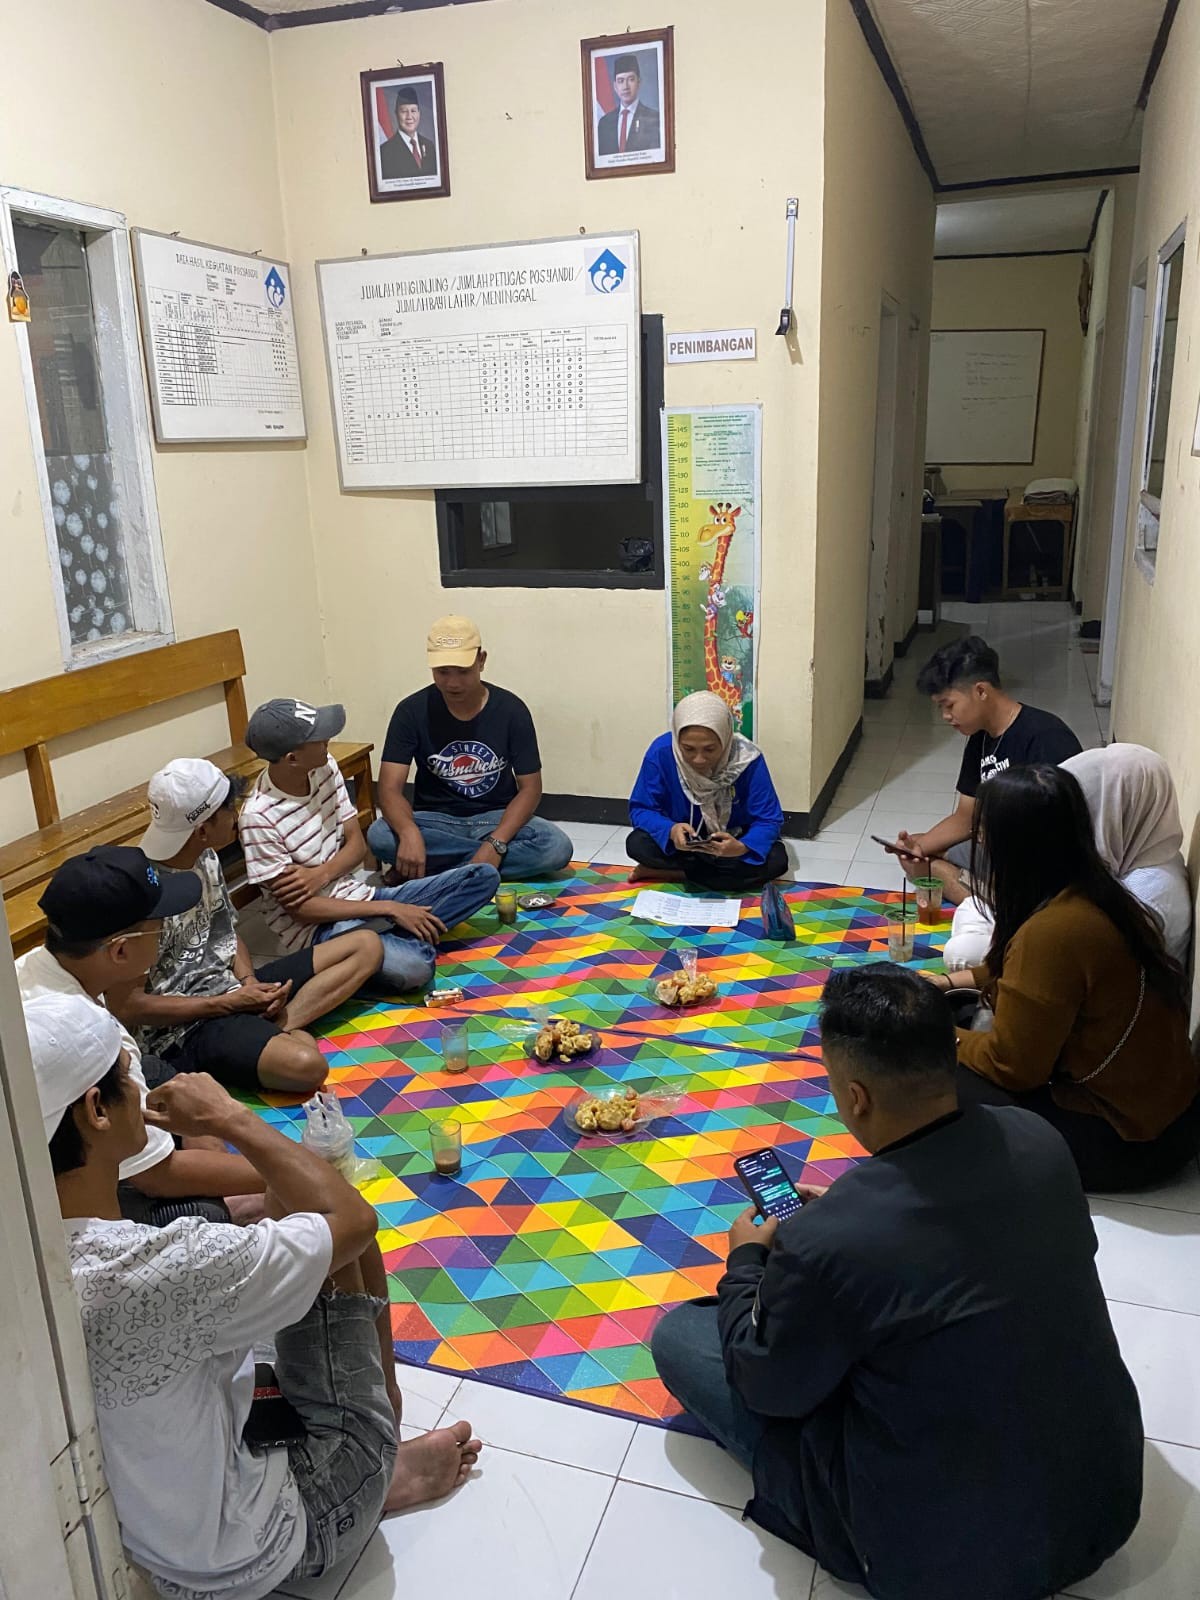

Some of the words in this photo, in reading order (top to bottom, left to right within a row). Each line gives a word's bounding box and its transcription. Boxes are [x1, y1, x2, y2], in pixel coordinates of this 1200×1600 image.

[360, 282, 394, 300] JUMLAH
[490, 270, 527, 287] PETUGAS
[530, 267, 574, 284] POSYANDU
[396, 297, 428, 314] JUMLAH
[670, 336, 753, 355] PENIMBANGAN
[452, 744, 490, 758] STREET
